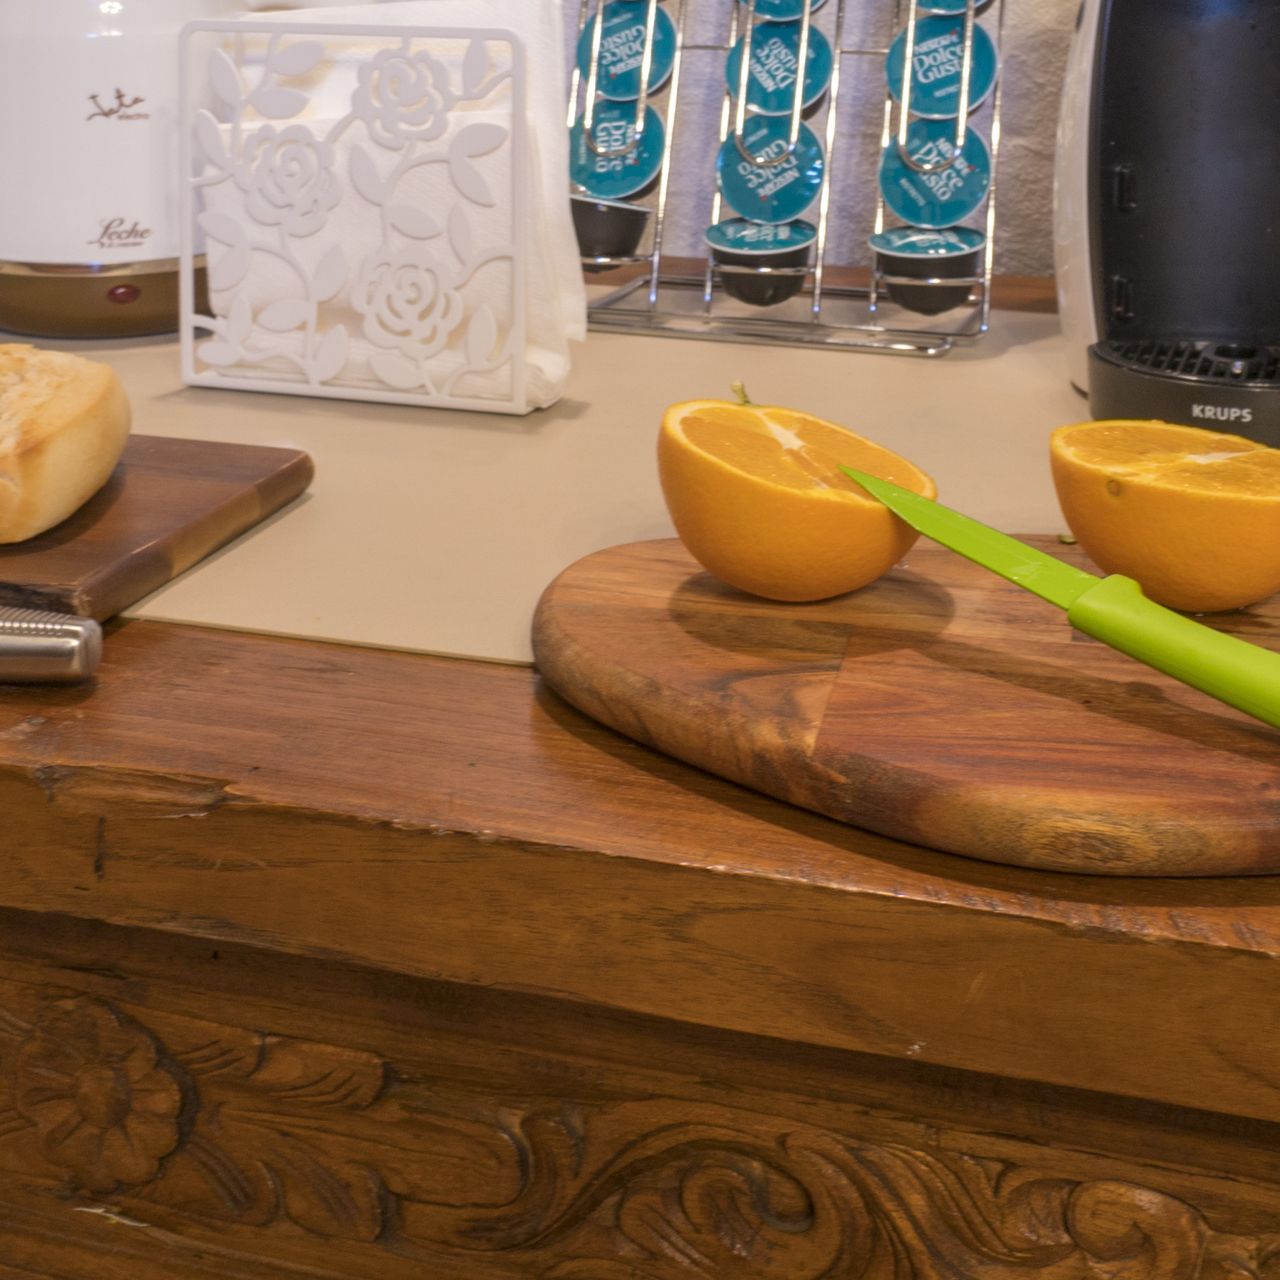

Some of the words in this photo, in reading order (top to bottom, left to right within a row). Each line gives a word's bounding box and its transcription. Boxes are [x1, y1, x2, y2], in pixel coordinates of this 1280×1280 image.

[767, 37, 799, 70] usto
[917, 59, 962, 84] Gust
[1192, 404, 1252, 422] KRUPS
